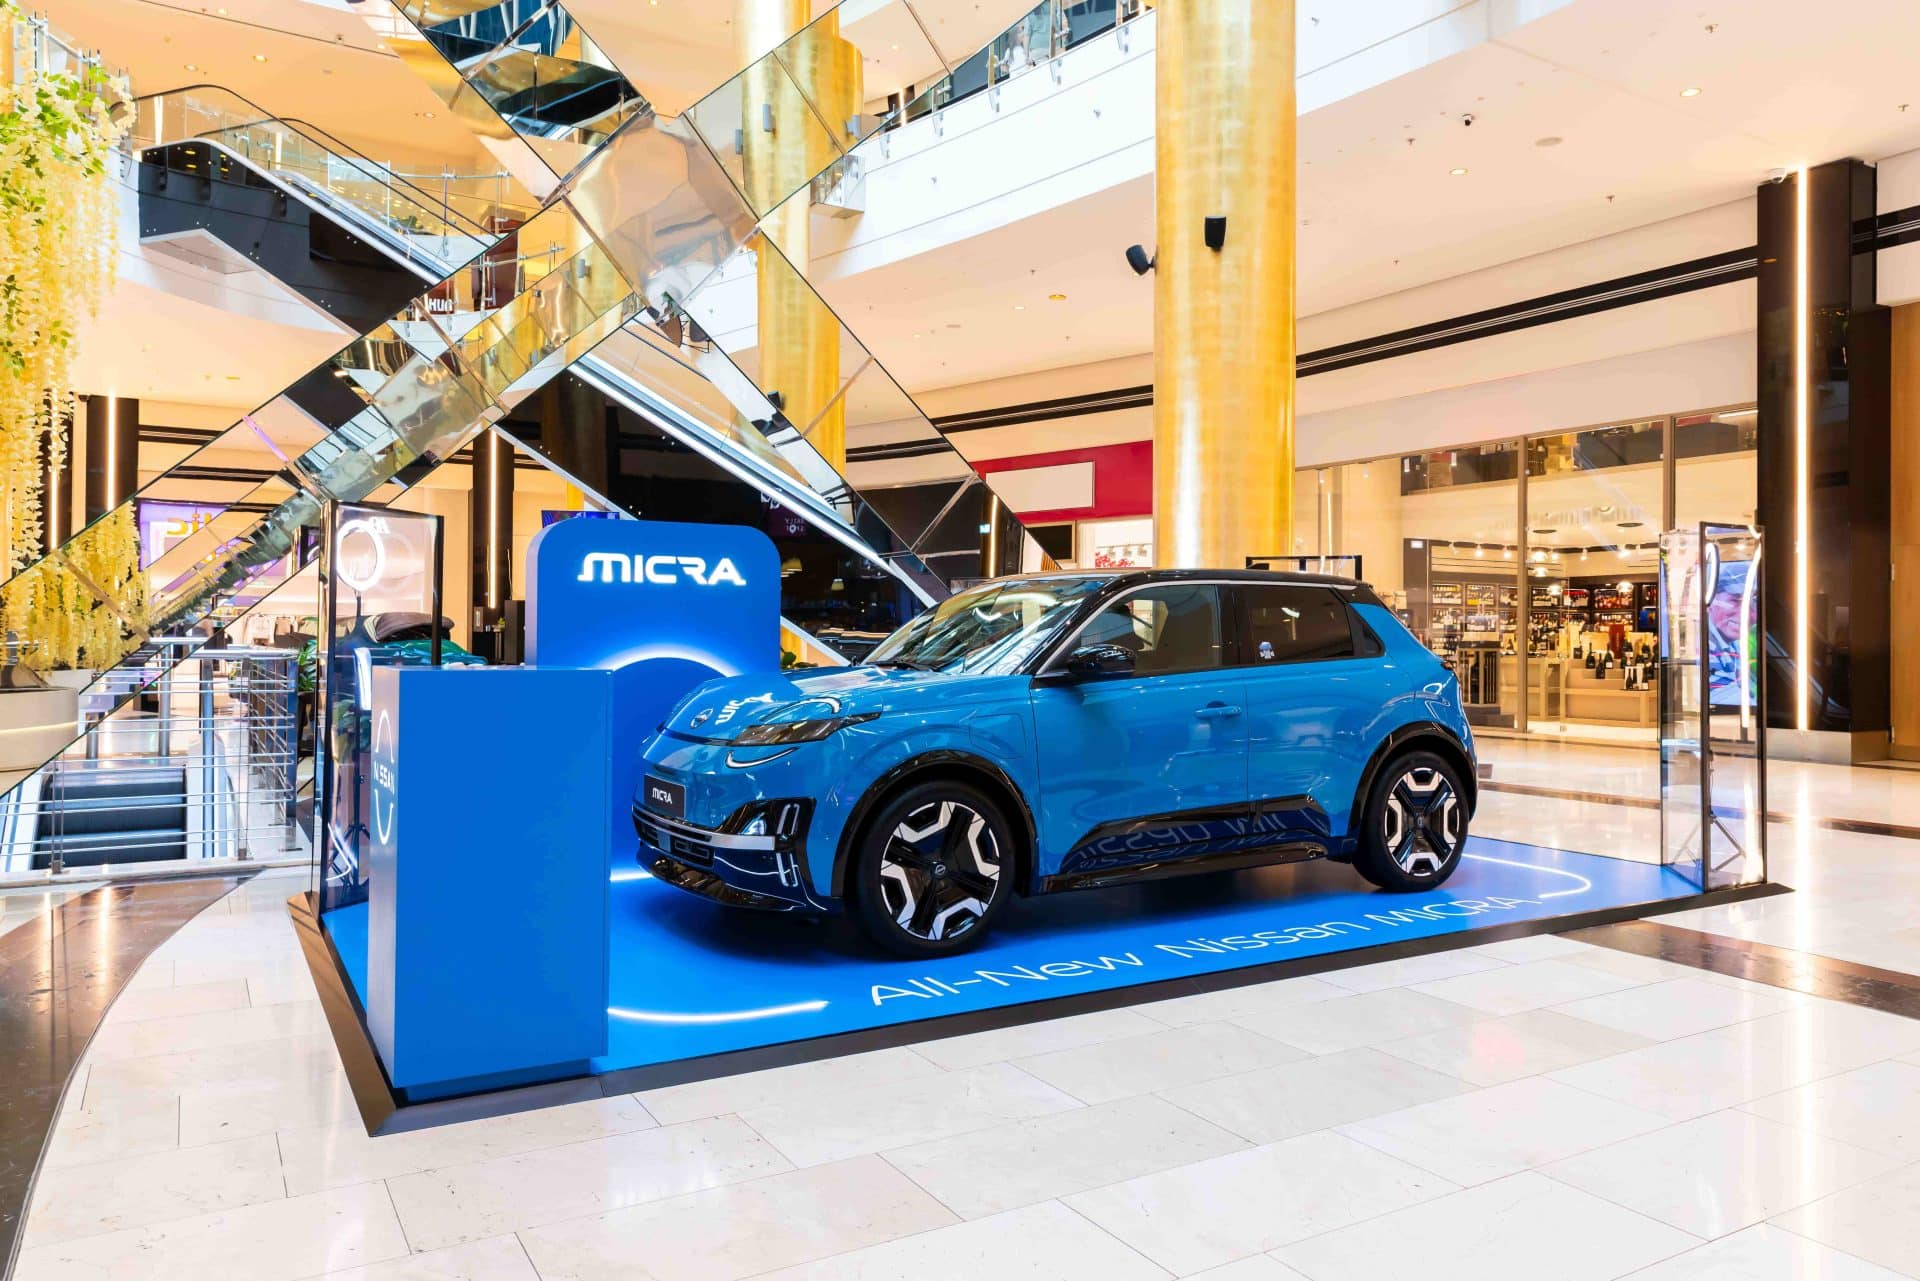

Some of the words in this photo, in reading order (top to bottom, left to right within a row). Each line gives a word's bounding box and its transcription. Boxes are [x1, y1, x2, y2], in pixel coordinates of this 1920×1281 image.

[577, 552, 747, 586] MICRA
[373, 759, 396, 796] NSSAN
[871, 952, 1143, 1006] All-New
[1154, 921, 1371, 958] Nissan
[1364, 896, 1543, 926] MICRA
